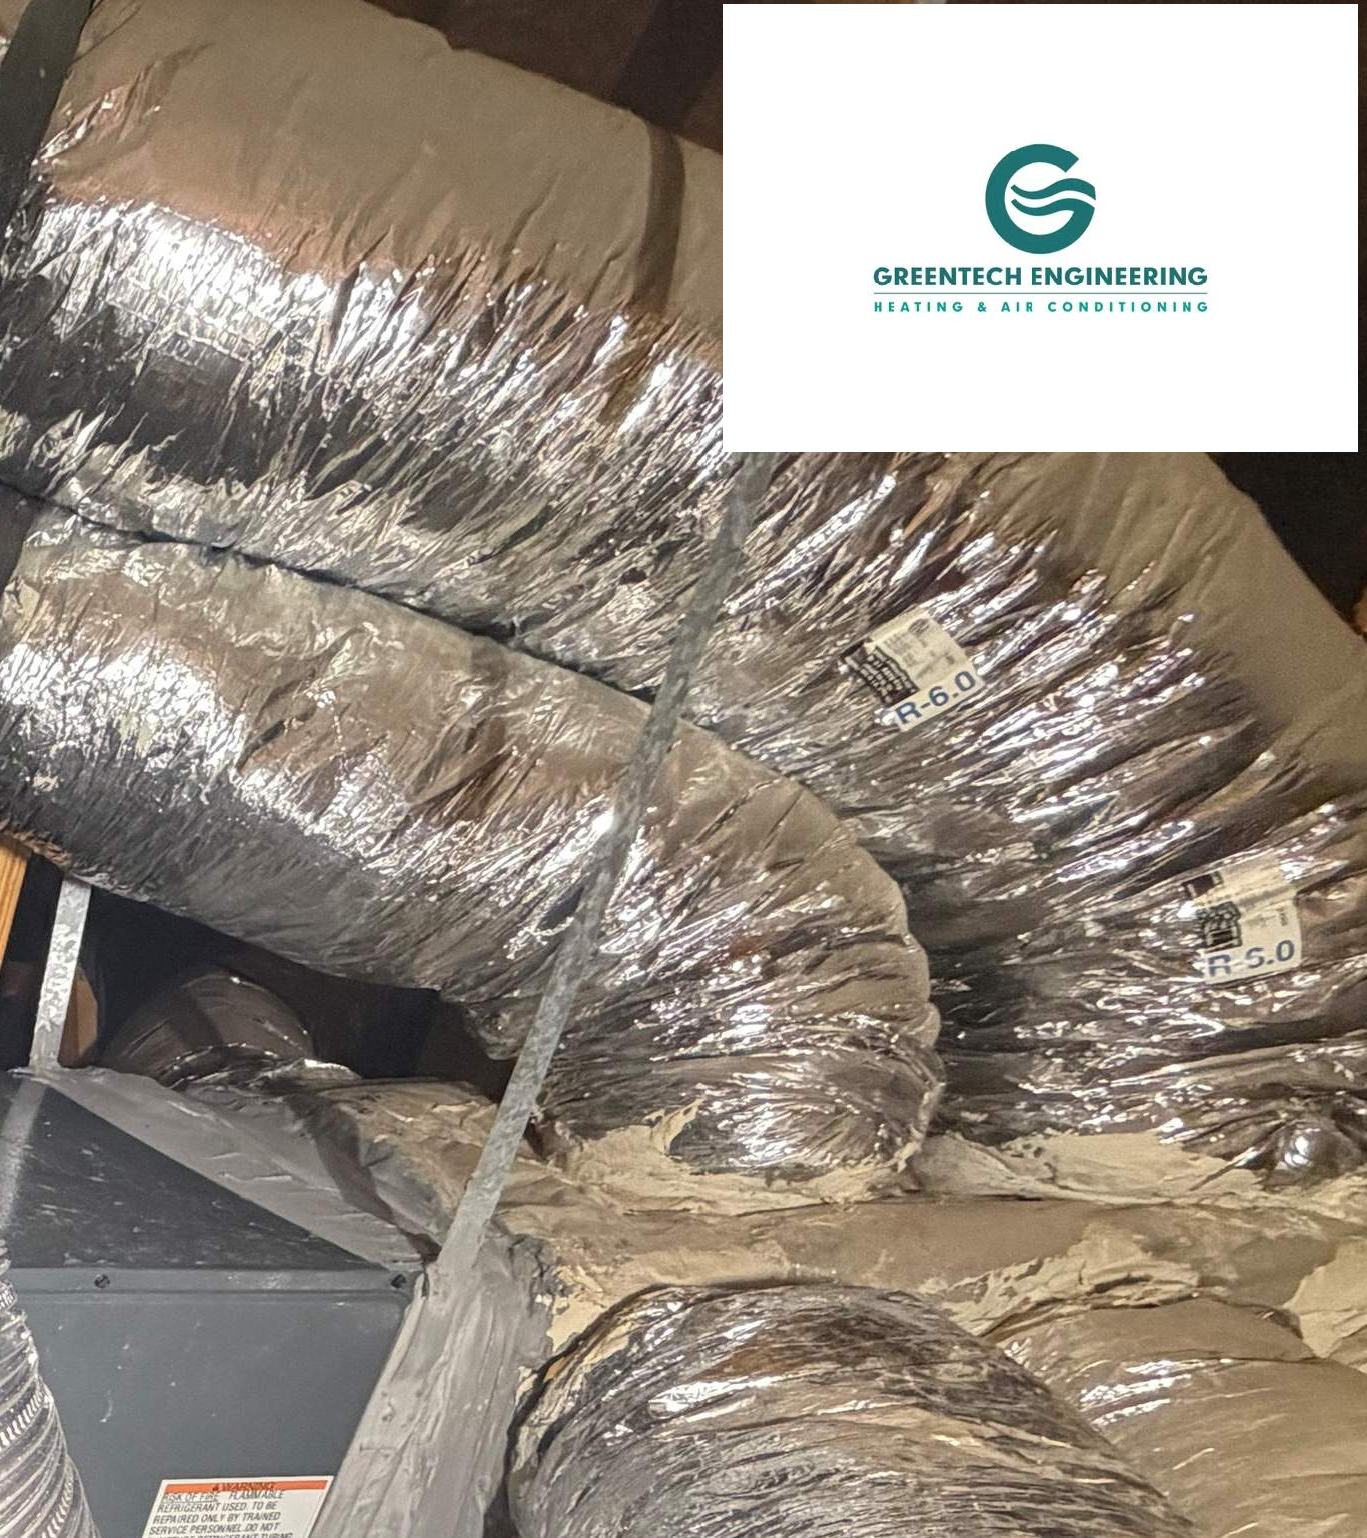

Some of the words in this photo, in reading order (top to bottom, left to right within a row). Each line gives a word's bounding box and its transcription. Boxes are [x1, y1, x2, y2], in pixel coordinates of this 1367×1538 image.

[895, 670, 975, 725] R-6.0
[157, 1502, 220, 1512] REFRIGERANT
[252, 1502, 263, 1510] TO
[265, 1501, 277, 1510] BE
[153, 1515, 199, 1524] REPAIRED
[201, 1514, 225, 1523] ONLY
[226, 1513, 240, 1521] BY
[242, 1512, 281, 1521] TRAINED
[149, 1526, 186, 1535] SERVICE
[260, 1523, 279, 1531] NOT
